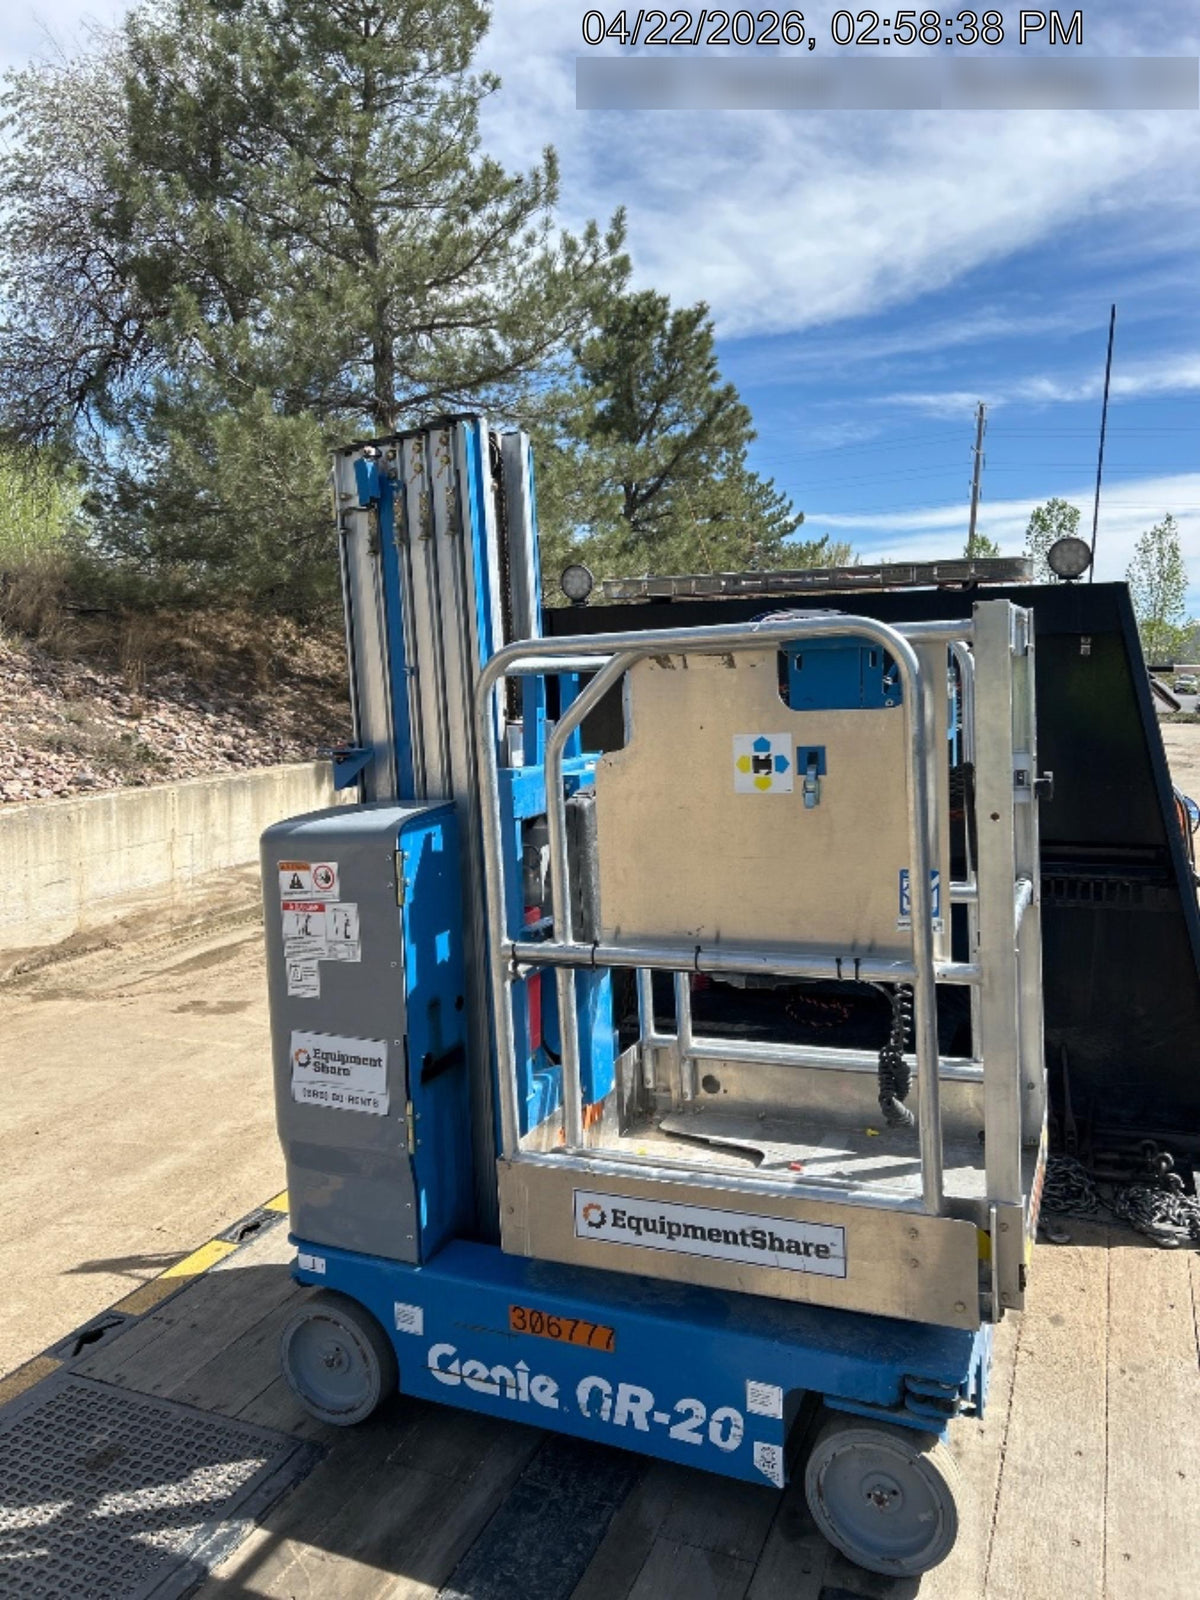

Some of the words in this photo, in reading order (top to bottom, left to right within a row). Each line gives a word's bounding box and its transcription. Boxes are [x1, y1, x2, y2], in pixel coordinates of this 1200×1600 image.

[313, 1048, 383, 1068] Equipment
[610, 1208, 830, 1260] EquipmentShare
[511, 1305, 616, 1351] 306777
[428, 1343, 559, 1409] Genie
[575, 1374, 744, 1452] GR-20
